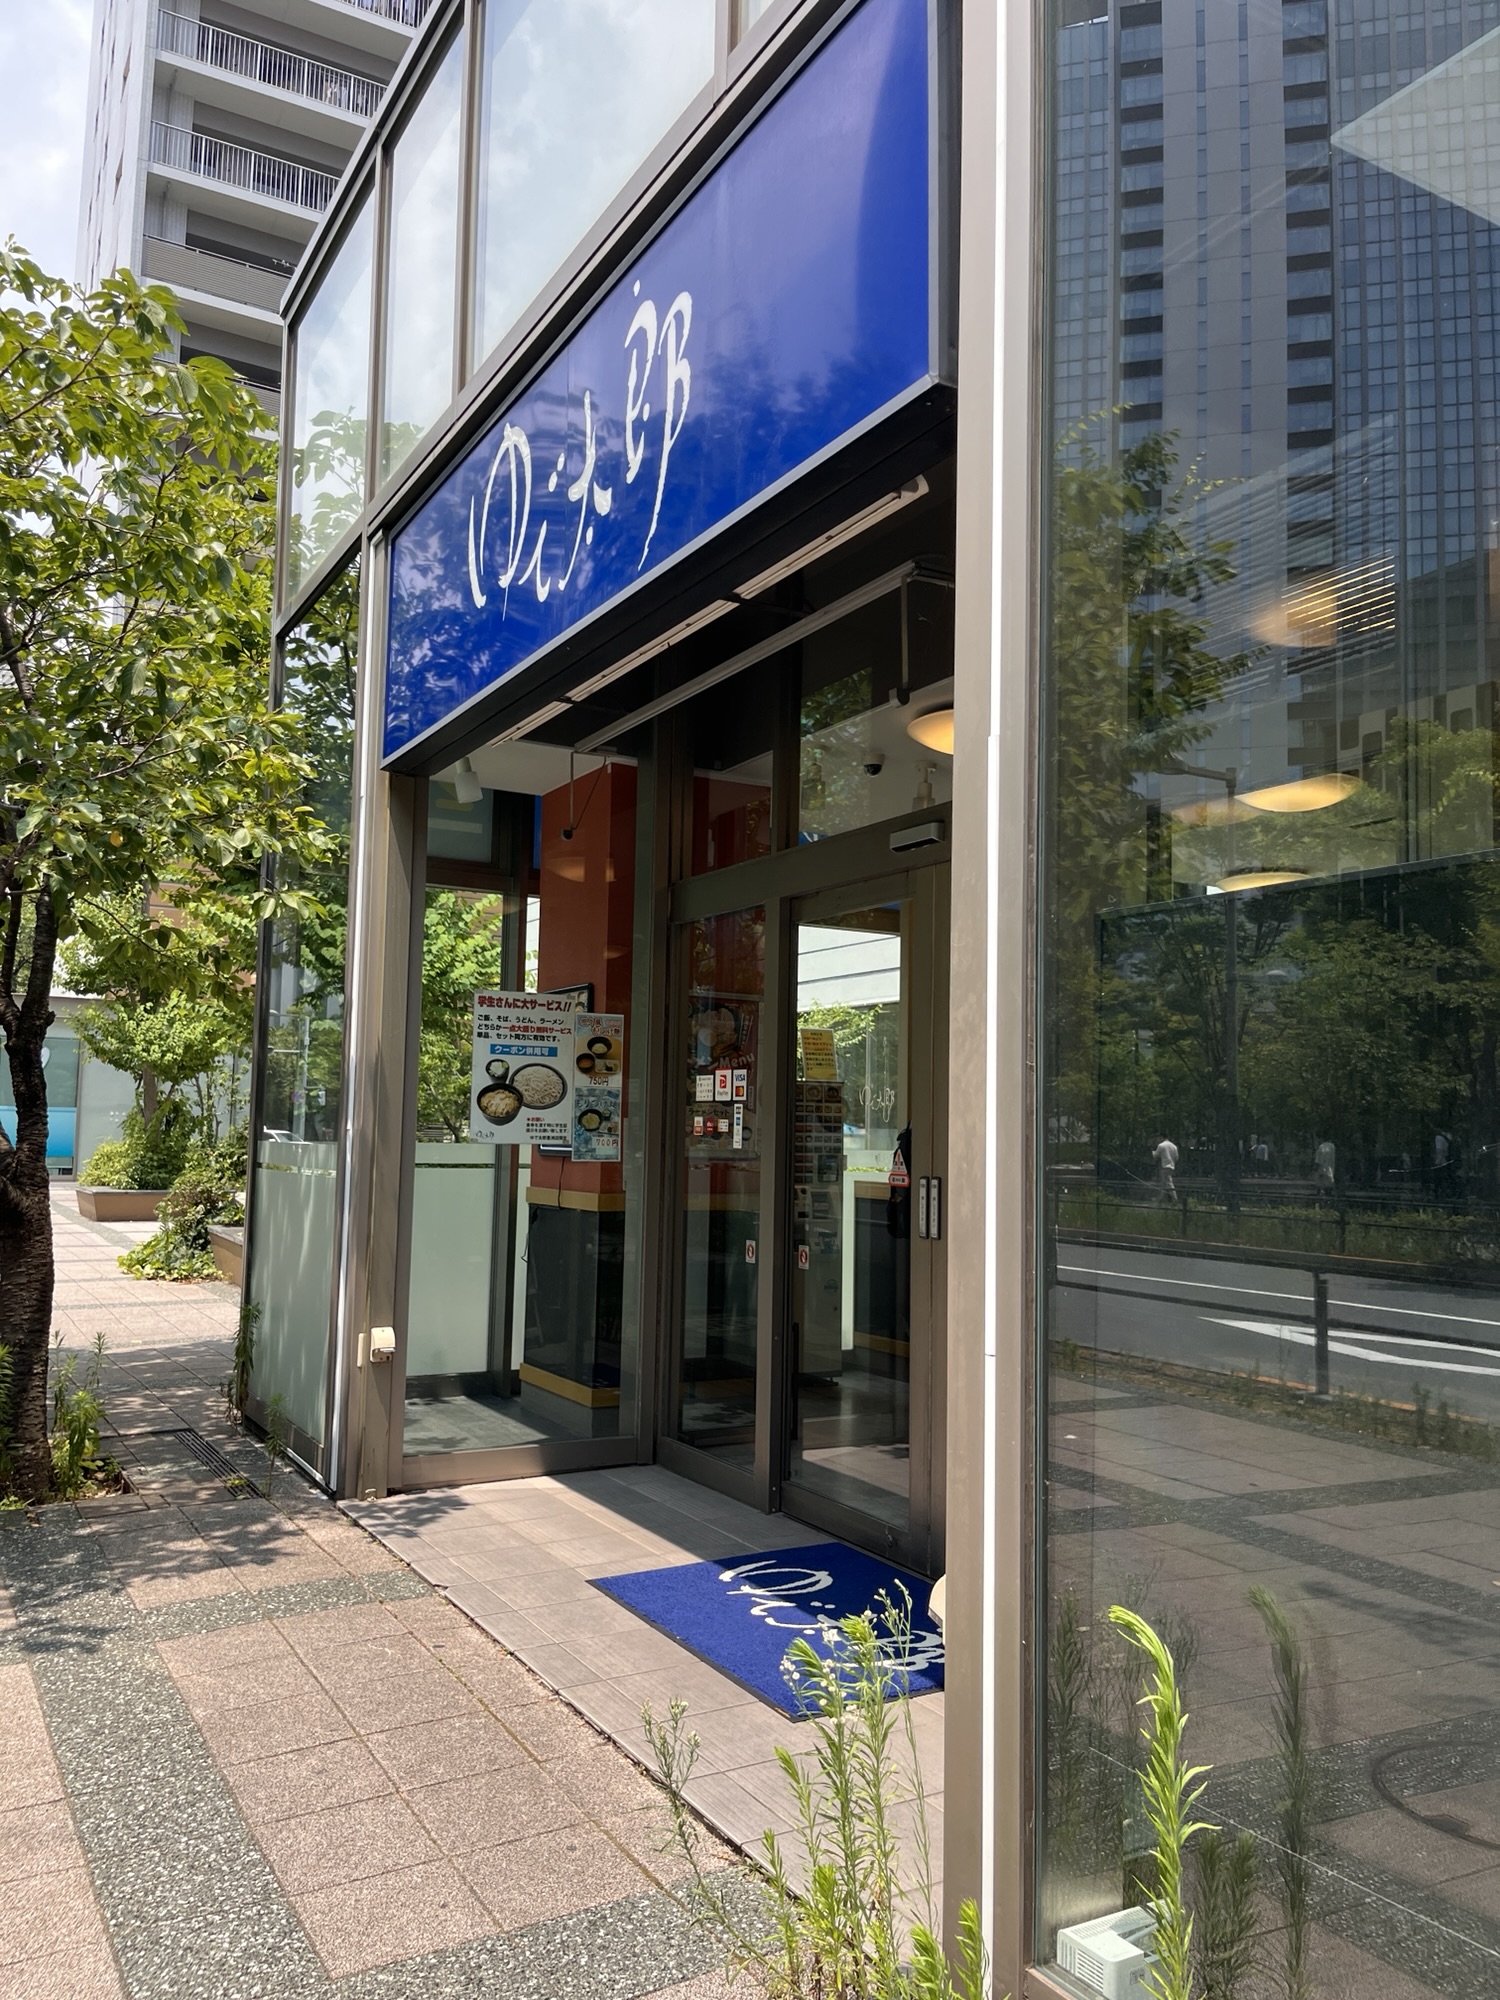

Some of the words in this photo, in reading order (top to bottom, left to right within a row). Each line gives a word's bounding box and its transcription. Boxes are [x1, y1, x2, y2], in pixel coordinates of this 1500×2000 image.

[719, 1053, 755, 1068] Menu
[589, 1076, 609, 1086] 750円
[735, 1074, 745, 1082] VISA
